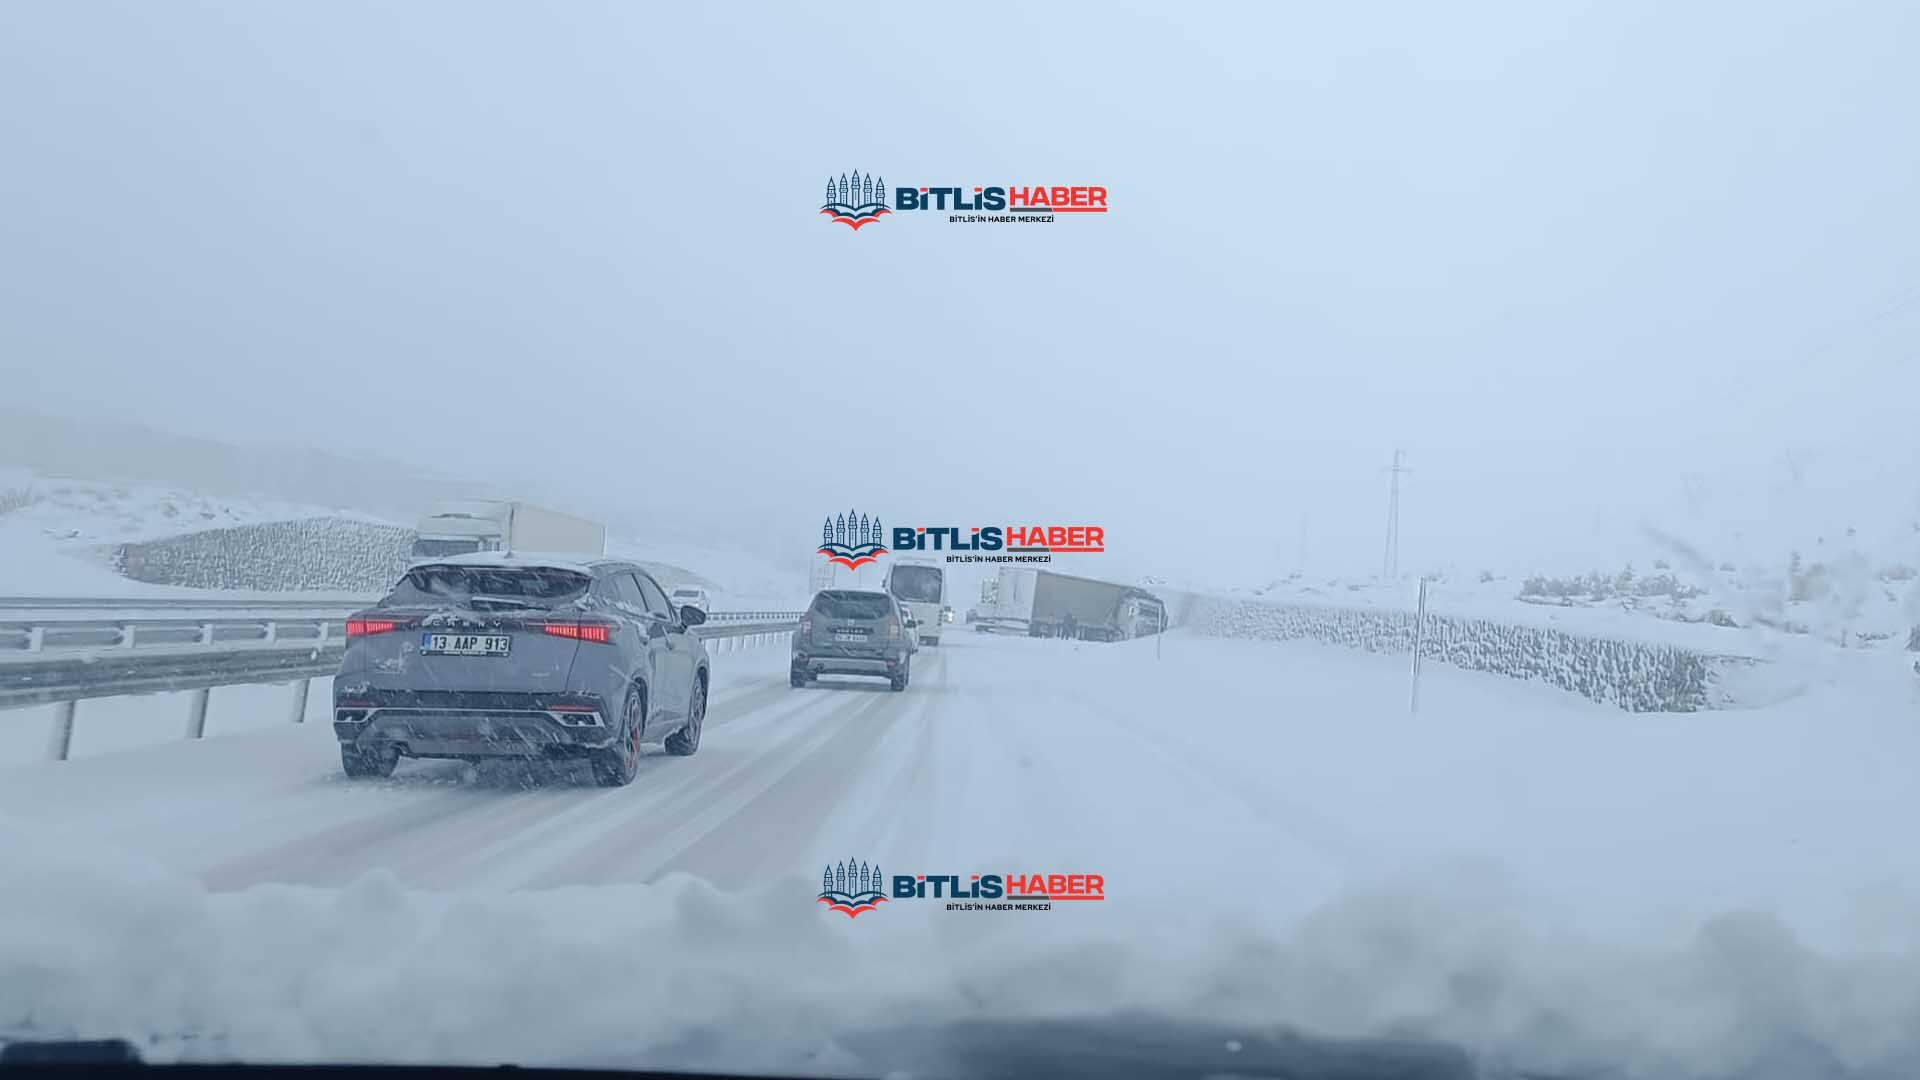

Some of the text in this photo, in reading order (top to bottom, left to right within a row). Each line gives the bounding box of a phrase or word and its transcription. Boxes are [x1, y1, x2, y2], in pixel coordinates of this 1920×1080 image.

[433, 636, 508, 650] 13 AAP 913
